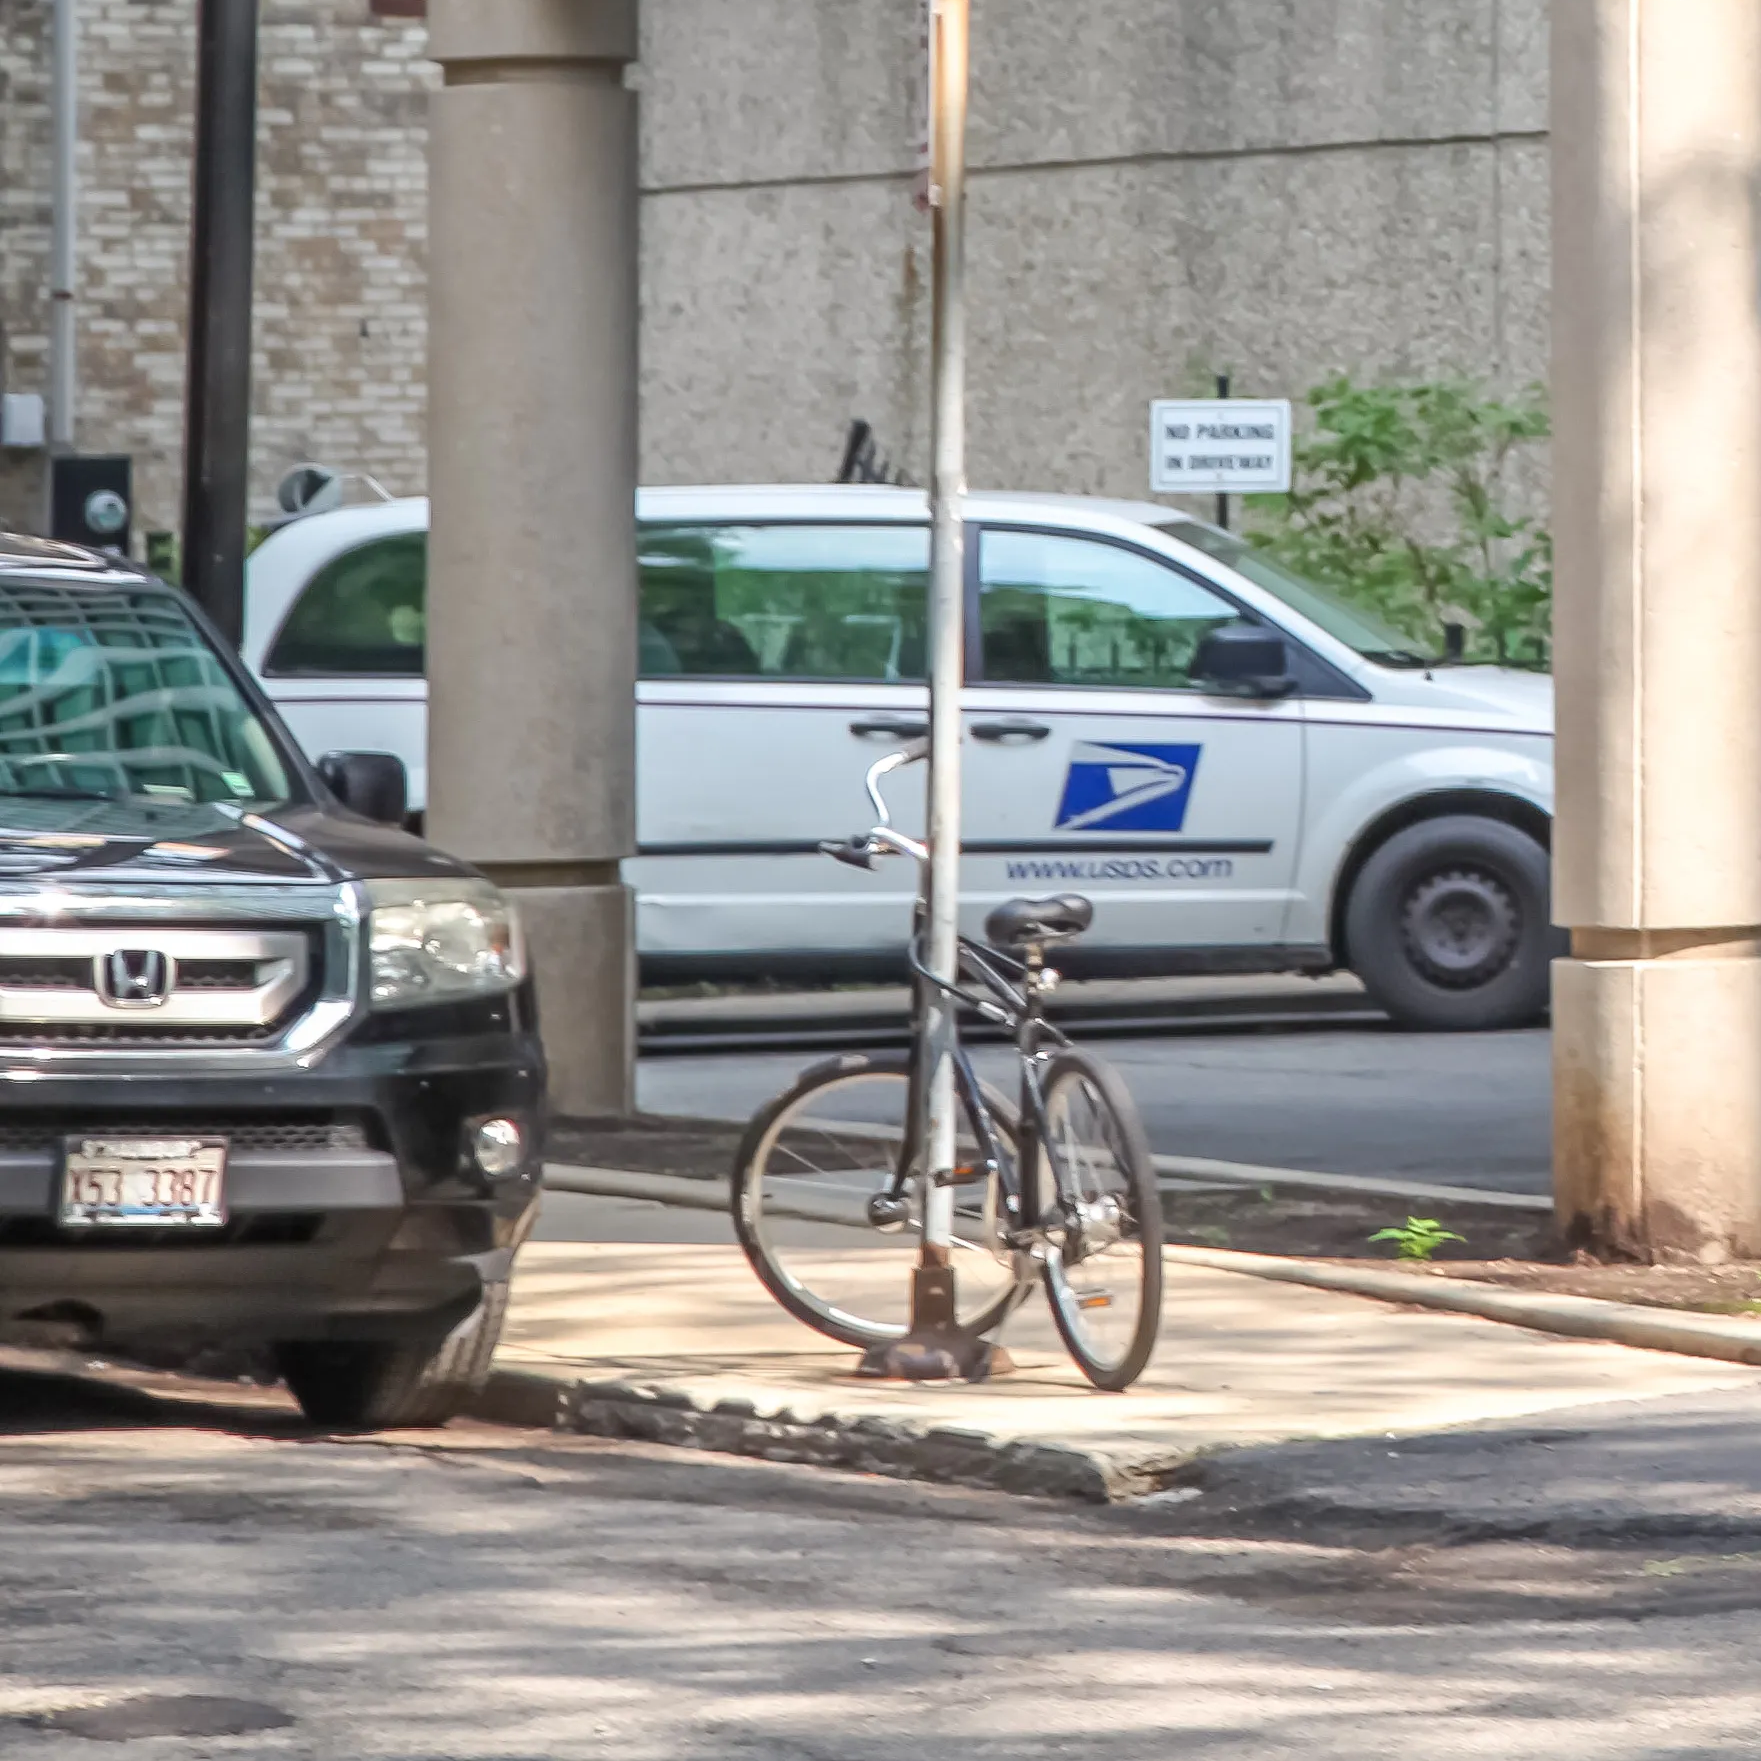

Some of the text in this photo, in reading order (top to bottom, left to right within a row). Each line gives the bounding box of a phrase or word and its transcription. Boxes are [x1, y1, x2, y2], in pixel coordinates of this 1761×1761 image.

[1165, 423, 1275, 439] NO PARKING
[1006, 857, 1232, 879] www.usps.com
